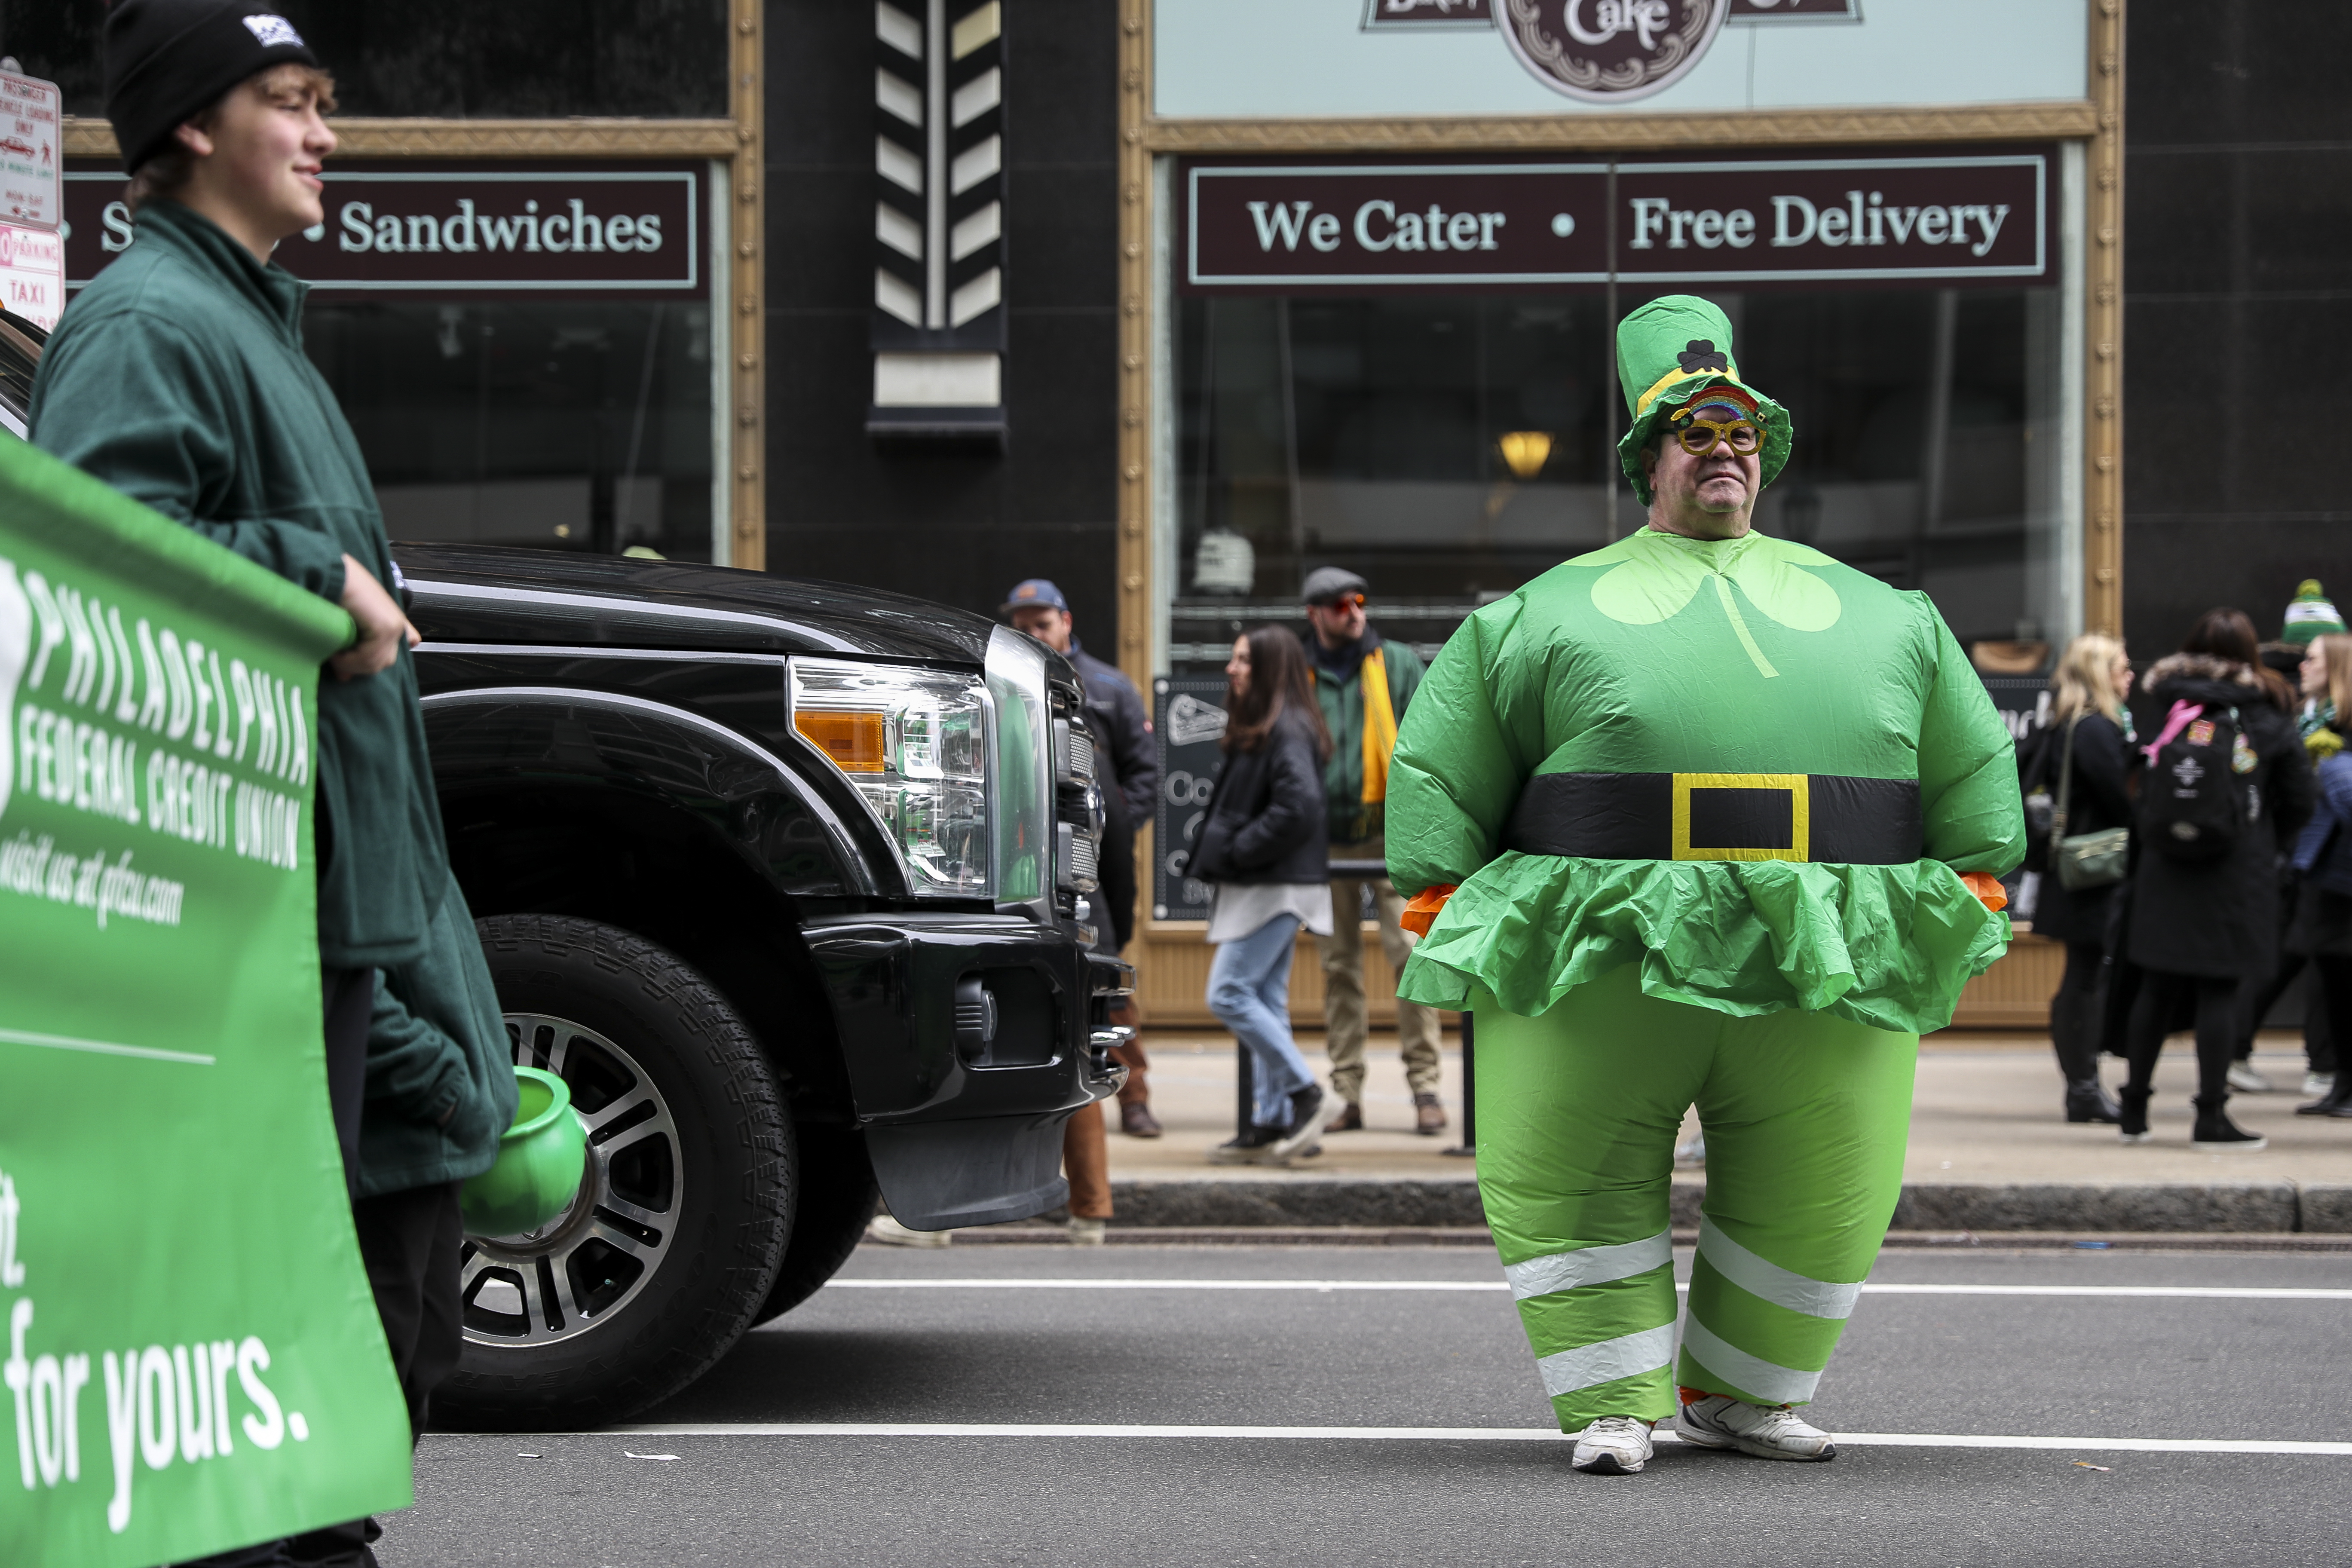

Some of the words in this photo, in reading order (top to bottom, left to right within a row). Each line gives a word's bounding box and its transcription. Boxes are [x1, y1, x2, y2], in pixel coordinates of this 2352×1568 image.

[1563, 0, 1670, 51] Cake
[0, 97, 22, 116] EHICLE
[3, 79, 46, 101] PASSNGER
[13, 238, 57, 263] PARKING
[339, 199, 662, 253] Sandwiches
[1245, 201, 1341, 252] We
[1353, 199, 1506, 252] Cater
[1628, 197, 1755, 249] Free
[1770, 190, 2010, 257] Delivery
[9, 279, 45, 305] TAXI
[24, 570, 308, 787] PHILADELPHIA
[19, 703, 141, 825] FEDERAL
[147, 748, 233, 850] CREDIT
[235, 781, 300, 871] UNION
[0, 826, 55, 898] visit
[46, 849, 78, 905] us
[74, 848, 106, 910] at
[97, 848, 184, 932] pfcu.com
[4, 1297, 89, 1491] for
[103, 1335, 309, 1534] yours.
